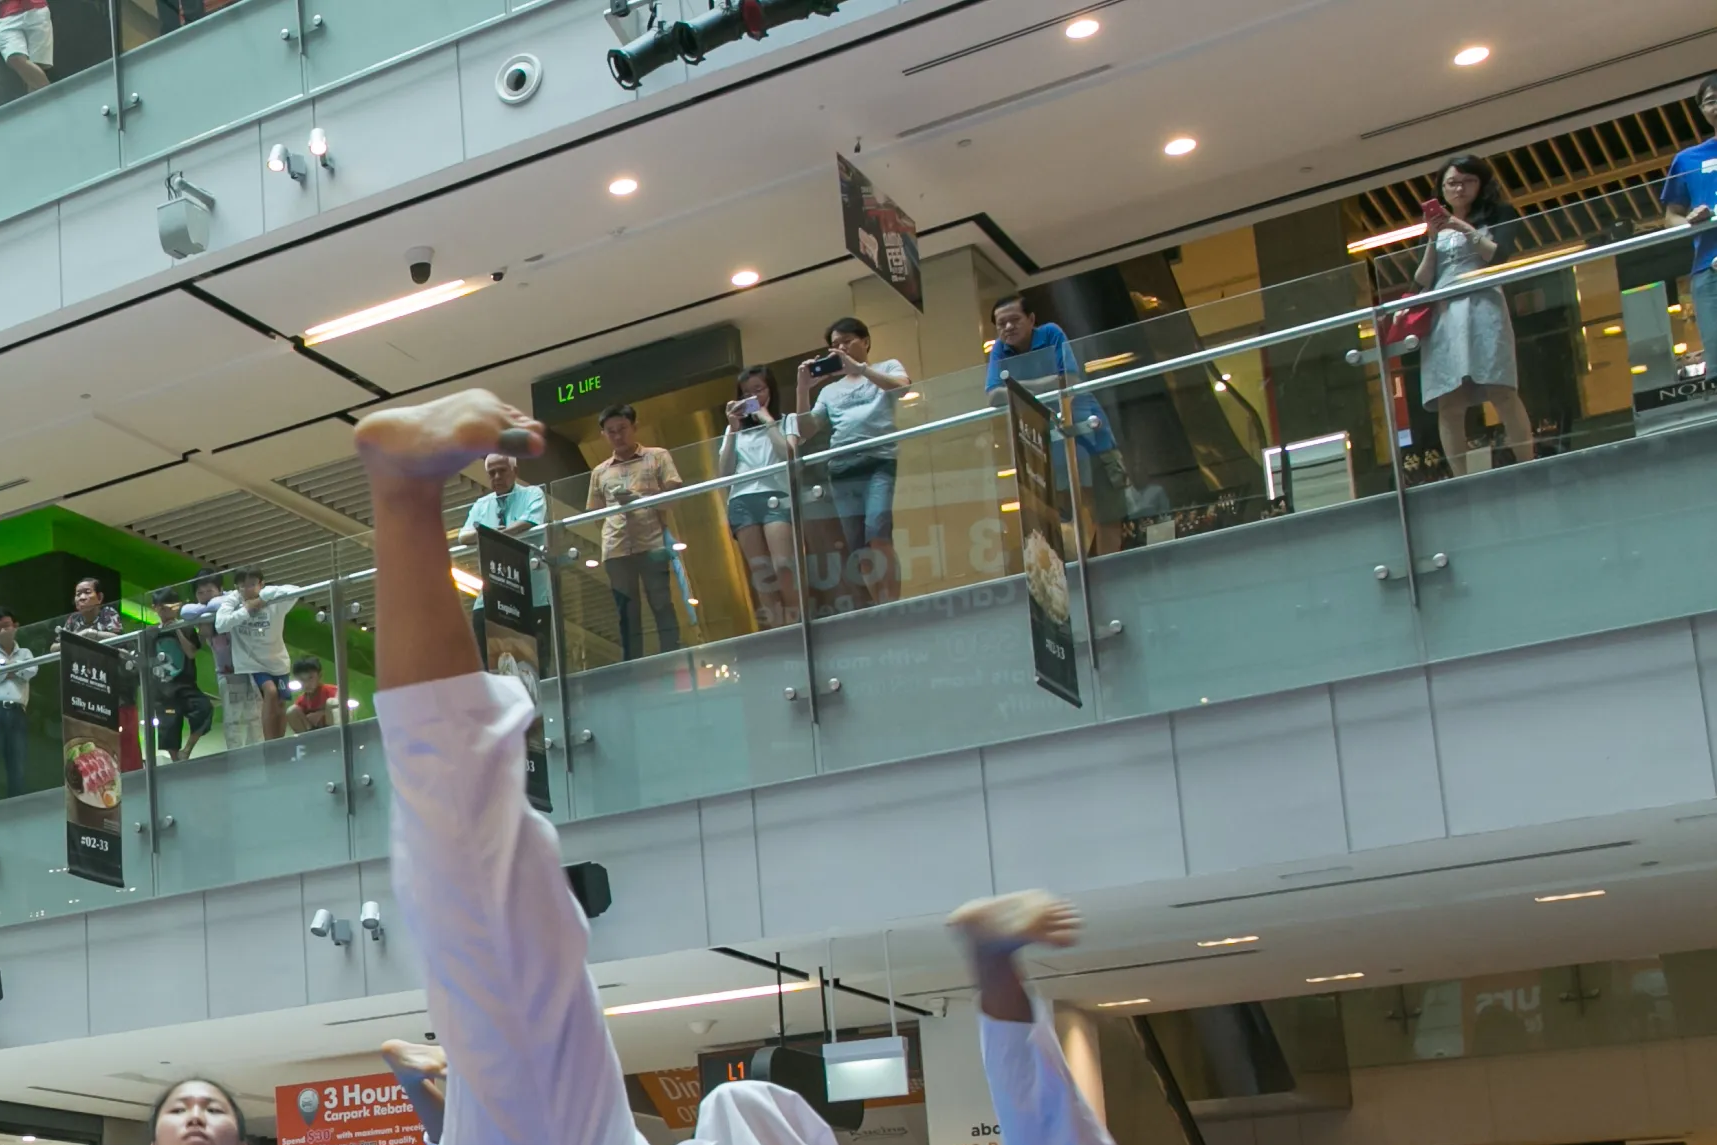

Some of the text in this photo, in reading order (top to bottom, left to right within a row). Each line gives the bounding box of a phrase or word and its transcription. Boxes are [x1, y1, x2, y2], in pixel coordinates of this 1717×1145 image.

[557, 375, 602, 403] L2 LIFE
[80, 836, 110, 852] #02-33
[727, 1061, 746, 1082] L1
[324, 1083, 410, 1109] 3 Hours
[324, 1102, 414, 1123] Carpark Rebate
[336, 1130, 354, 1140] with
[354, 1127, 393, 1138] maximum
